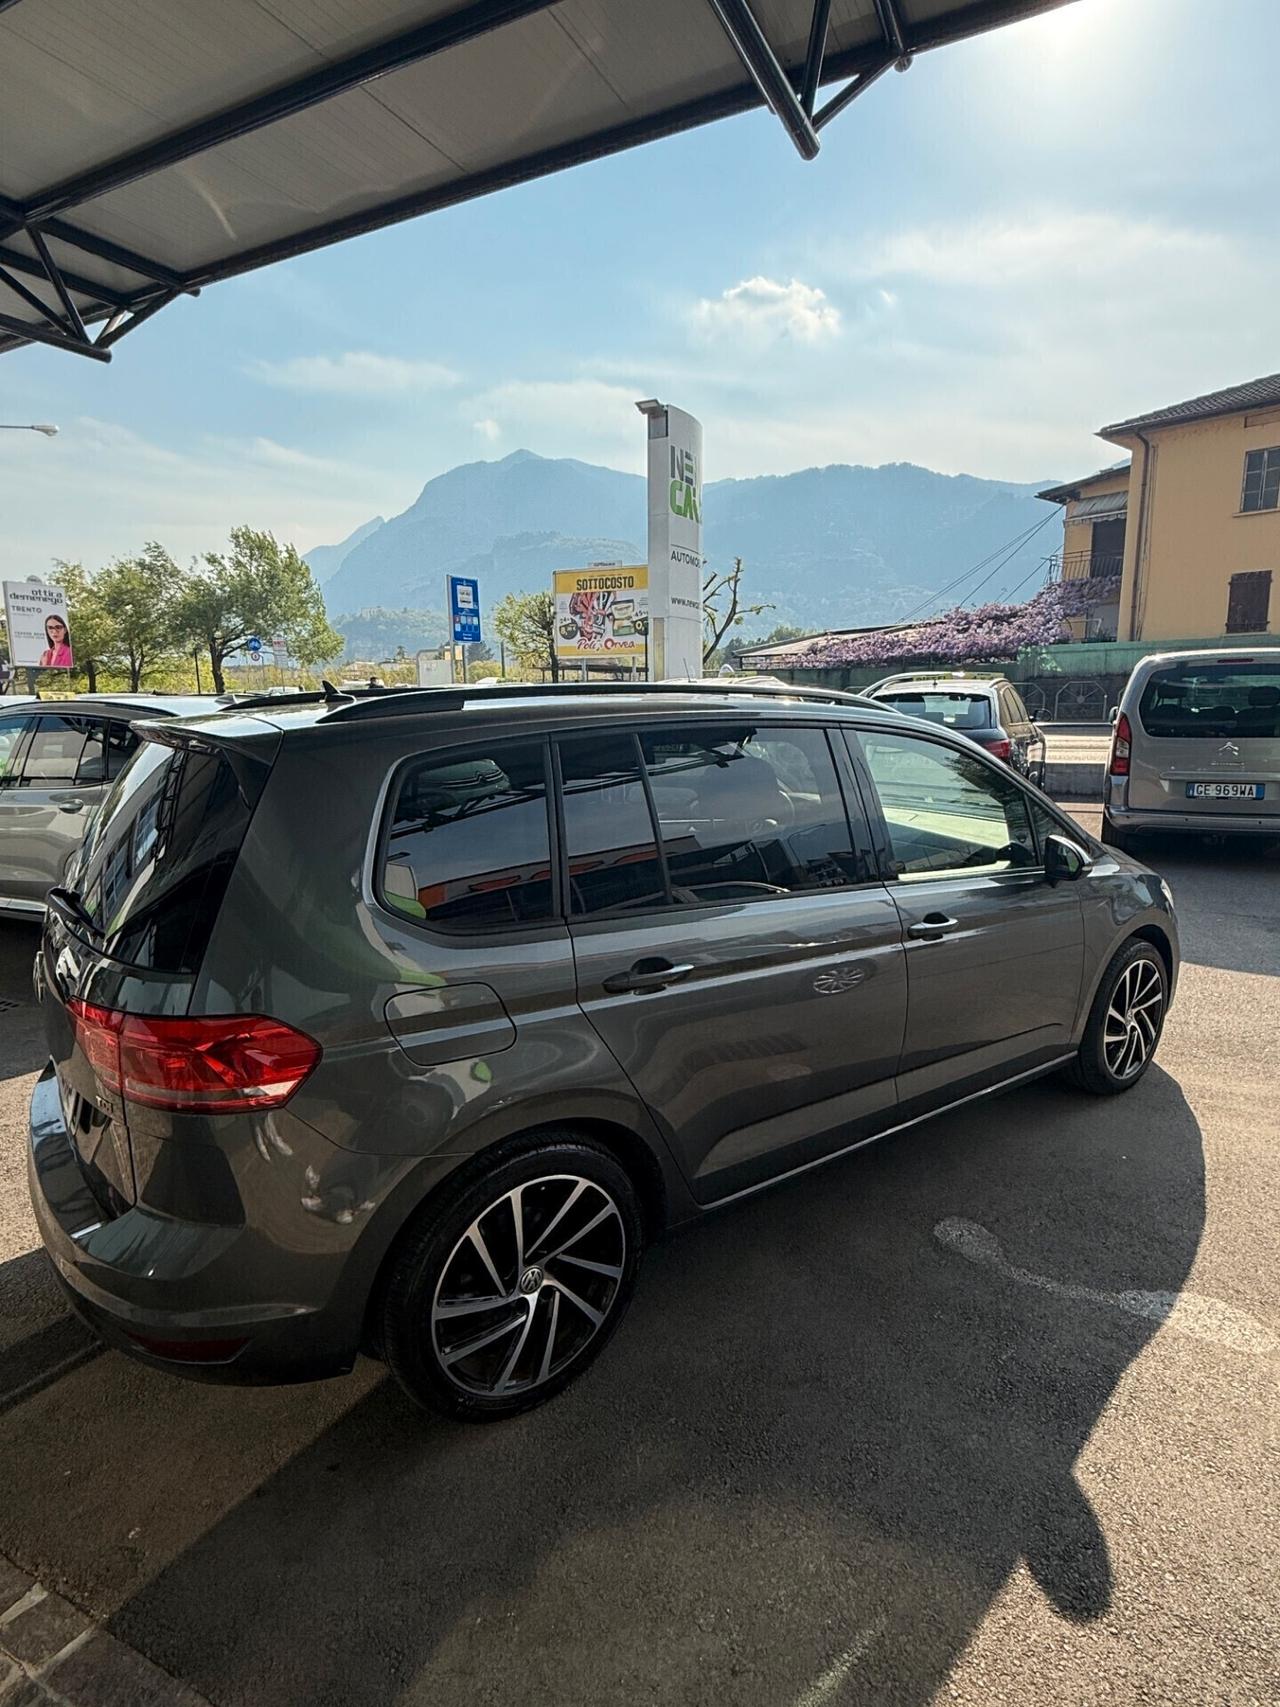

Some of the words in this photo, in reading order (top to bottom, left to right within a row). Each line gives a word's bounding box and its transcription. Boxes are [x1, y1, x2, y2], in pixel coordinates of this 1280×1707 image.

[670, 444, 697, 486] NE
[671, 550, 701, 568] AUTOMO
[576, 575, 634, 591] SOTTOCOSTO
[11, 605, 42, 613] TRENTO
[604, 638, 635, 650] Orvea
[1196, 785, 1211, 795] GE
[1215, 785, 1254, 796] 969WA
